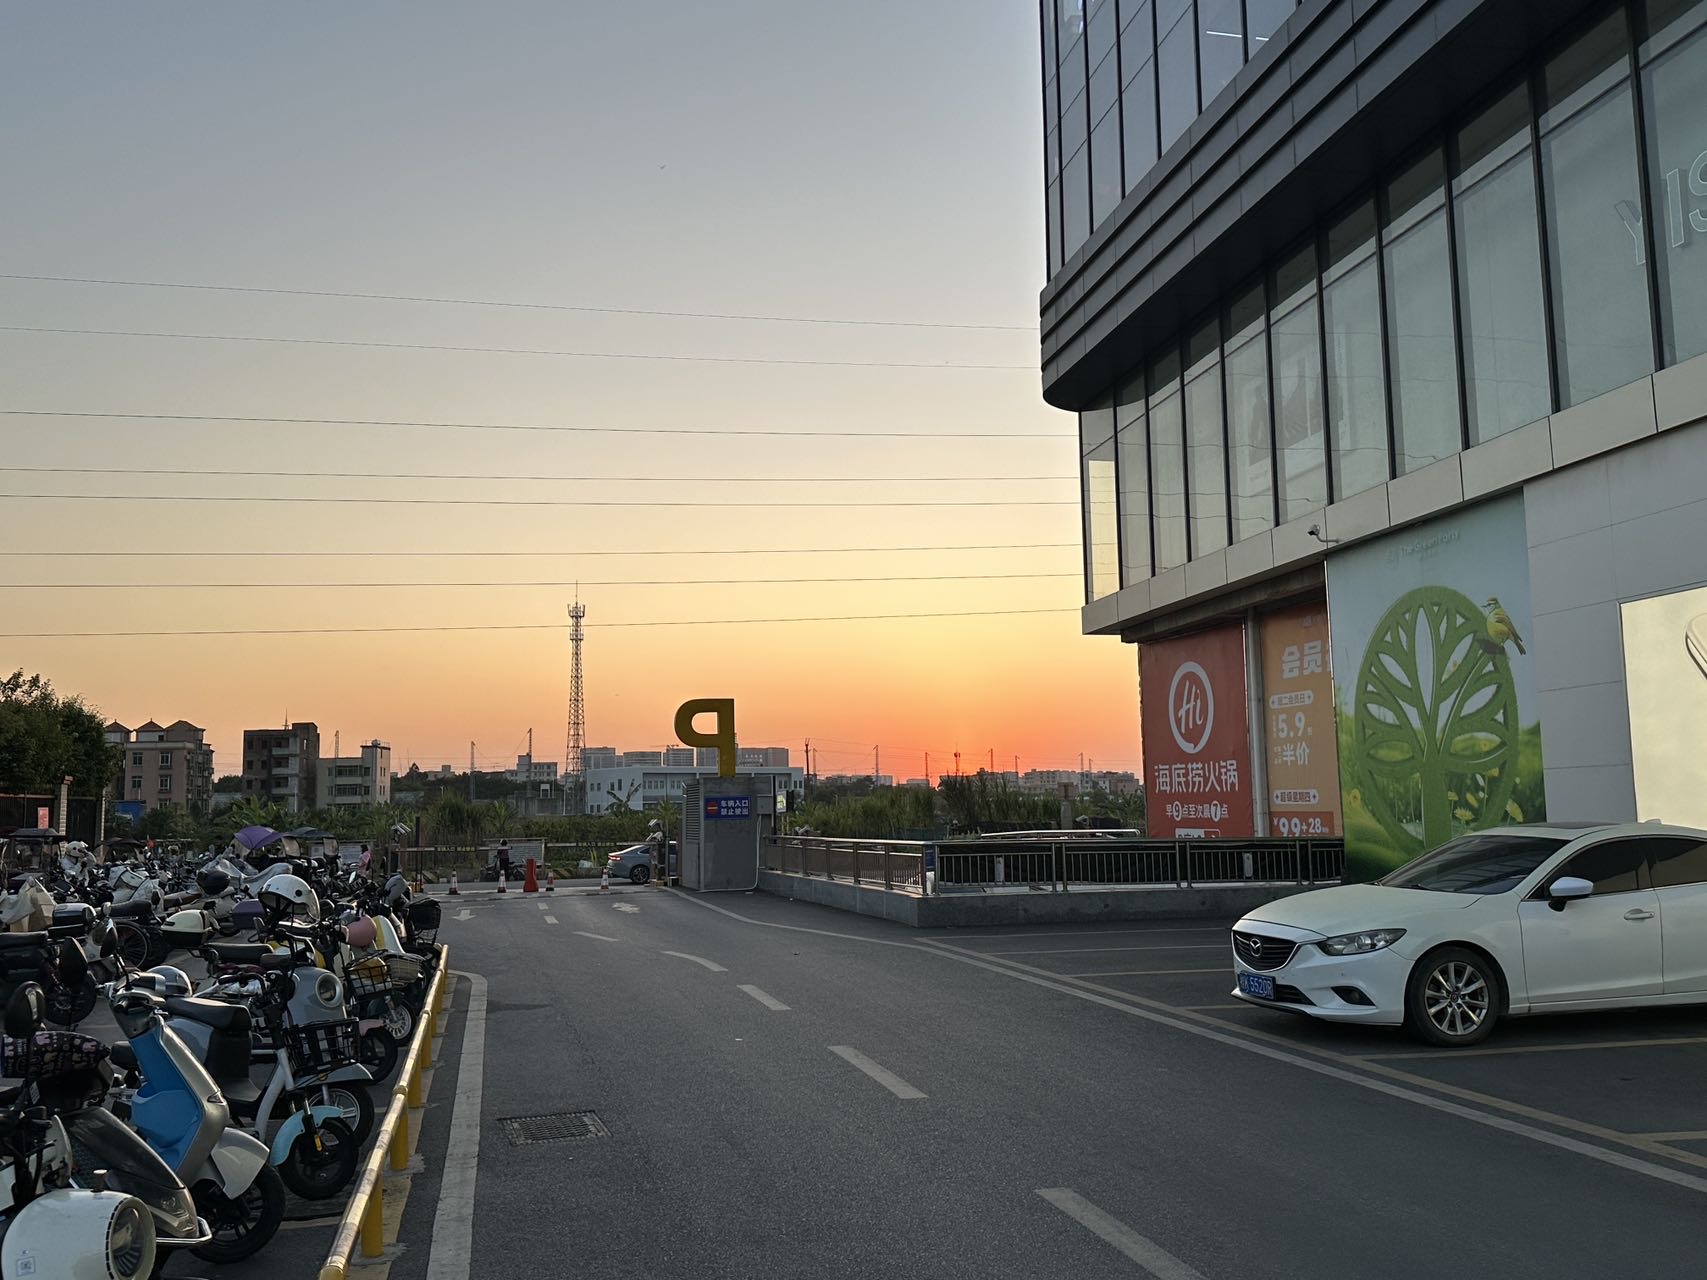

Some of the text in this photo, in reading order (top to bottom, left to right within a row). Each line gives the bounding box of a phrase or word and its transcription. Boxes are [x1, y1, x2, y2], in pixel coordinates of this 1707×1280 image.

[1282, 640, 1331, 679] 会员
[1178, 679, 1203, 734] Hi
[1283, 741, 1310, 766] 半价
[1154, 760, 1239, 794] 海底捞火锅
[720, 799, 749, 807] 车辆入口
